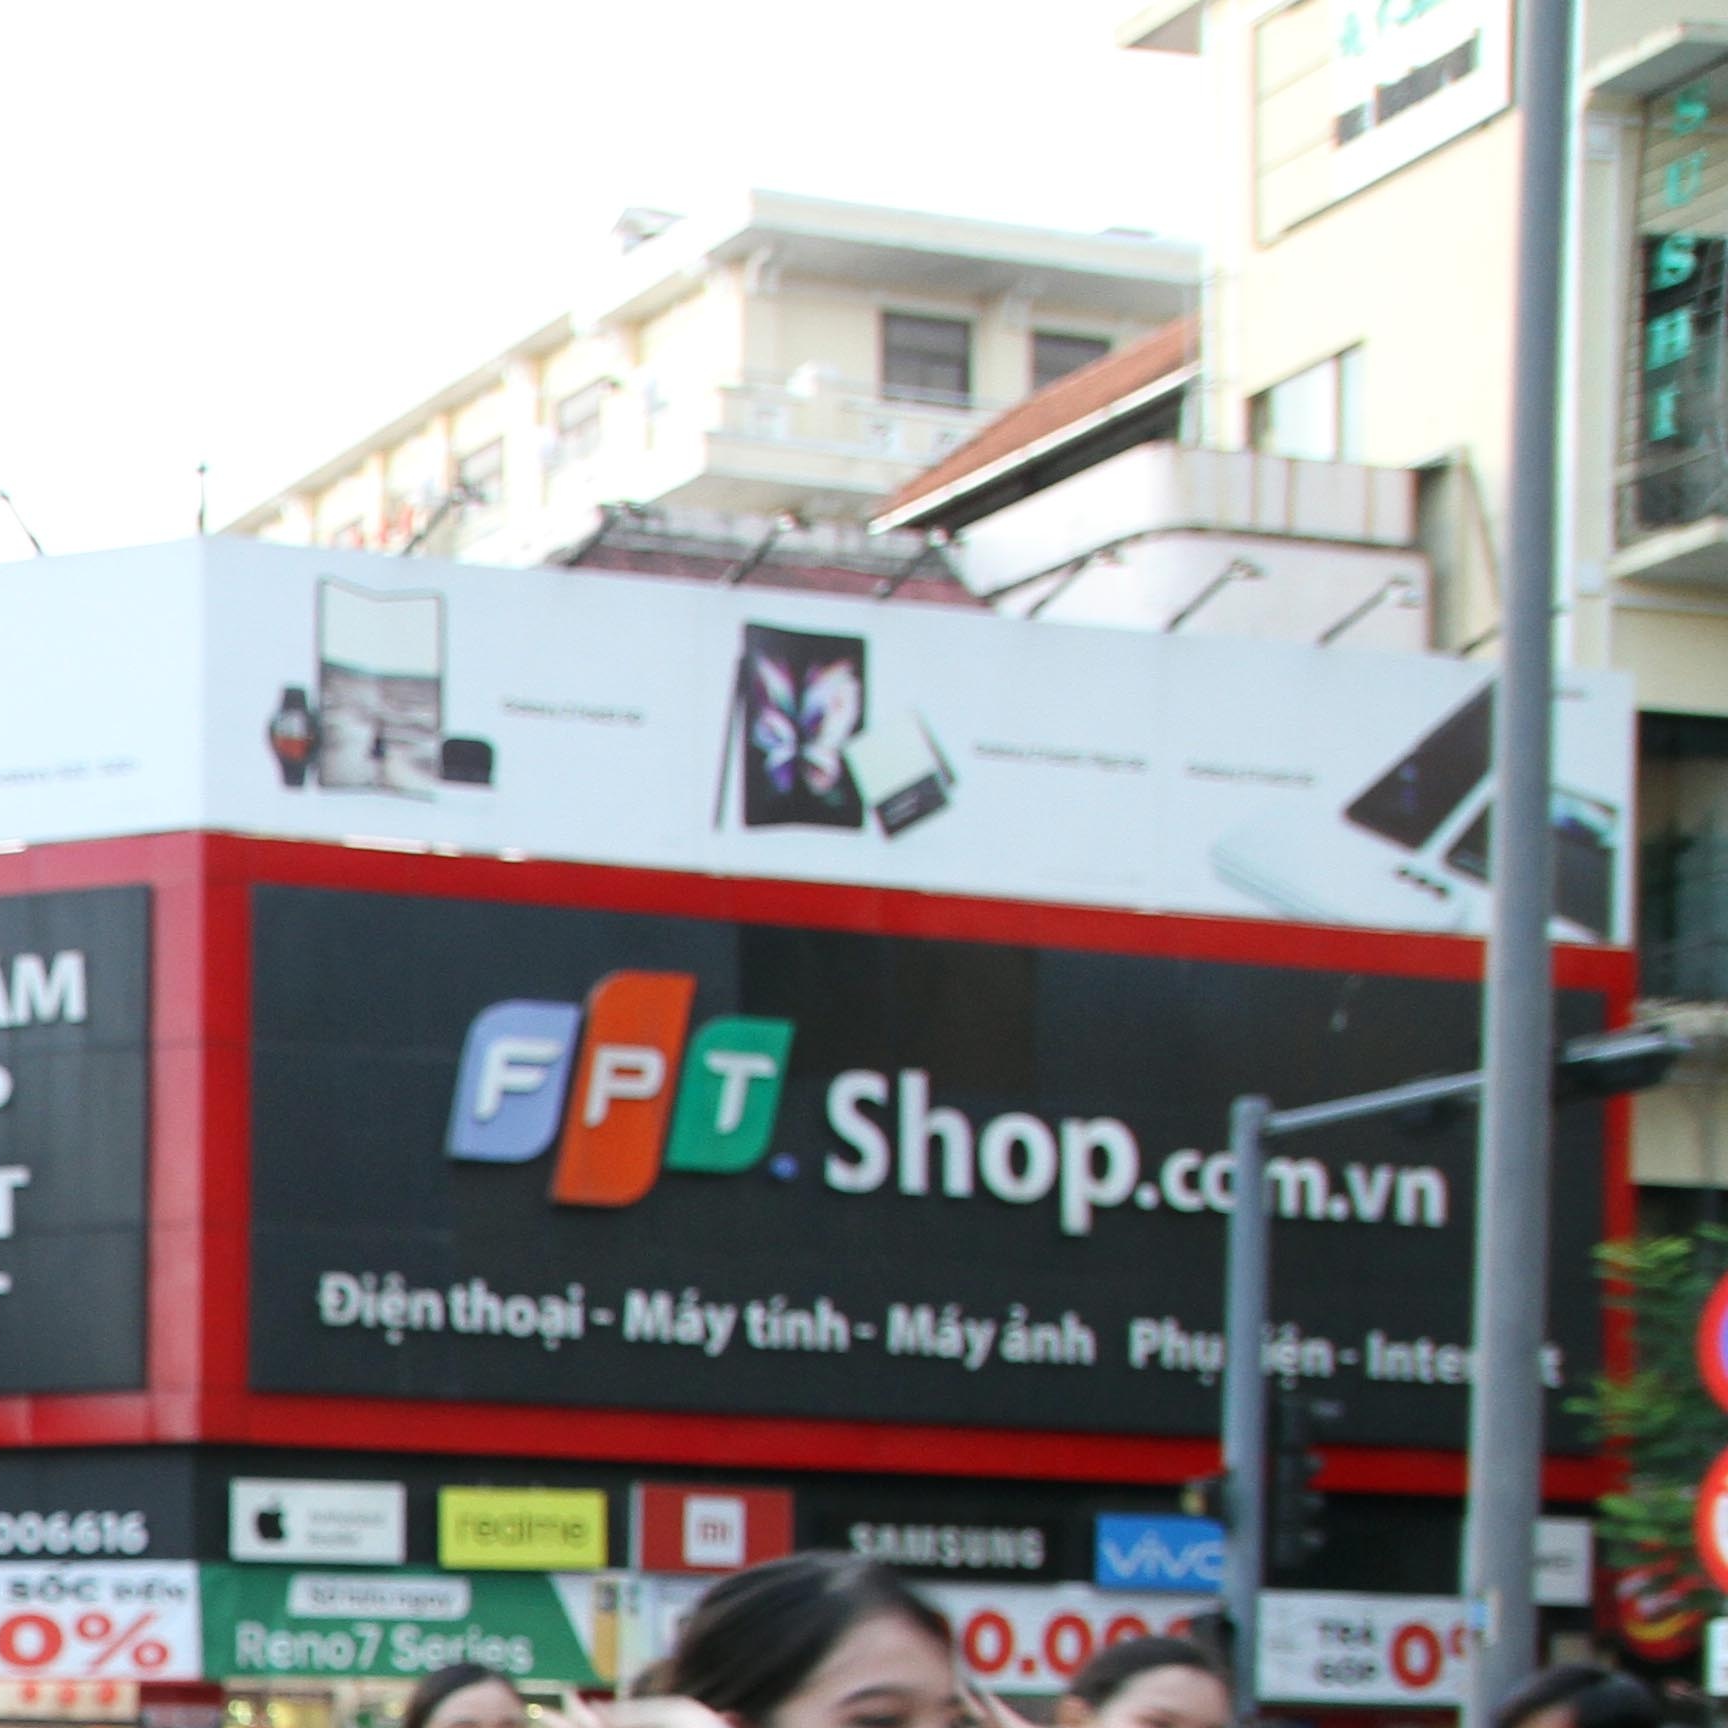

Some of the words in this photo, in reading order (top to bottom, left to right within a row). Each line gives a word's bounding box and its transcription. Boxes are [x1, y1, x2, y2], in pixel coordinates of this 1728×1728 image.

[473, 1037, 778, 1135] FPT
[318, 1271, 443, 1345] Điện
[448, 1278, 585, 1350] thoại
[623, 1288, 737, 1357] Máy
[745, 1293, 851, 1351] tính
[886, 1302, 993, 1370] Máy
[999, 1302, 1096, 1366] ảnh
[1128, 1316, 1225, 1387] Phụ
[1258, 1321, 1336, 1391] iện
[455, 1511, 591, 1550] realme
[848, 1522, 1044, 1569] SAMSUNG
[235, 1619, 384, 1670] Reno7
[390, 1622, 534, 1673] Series
